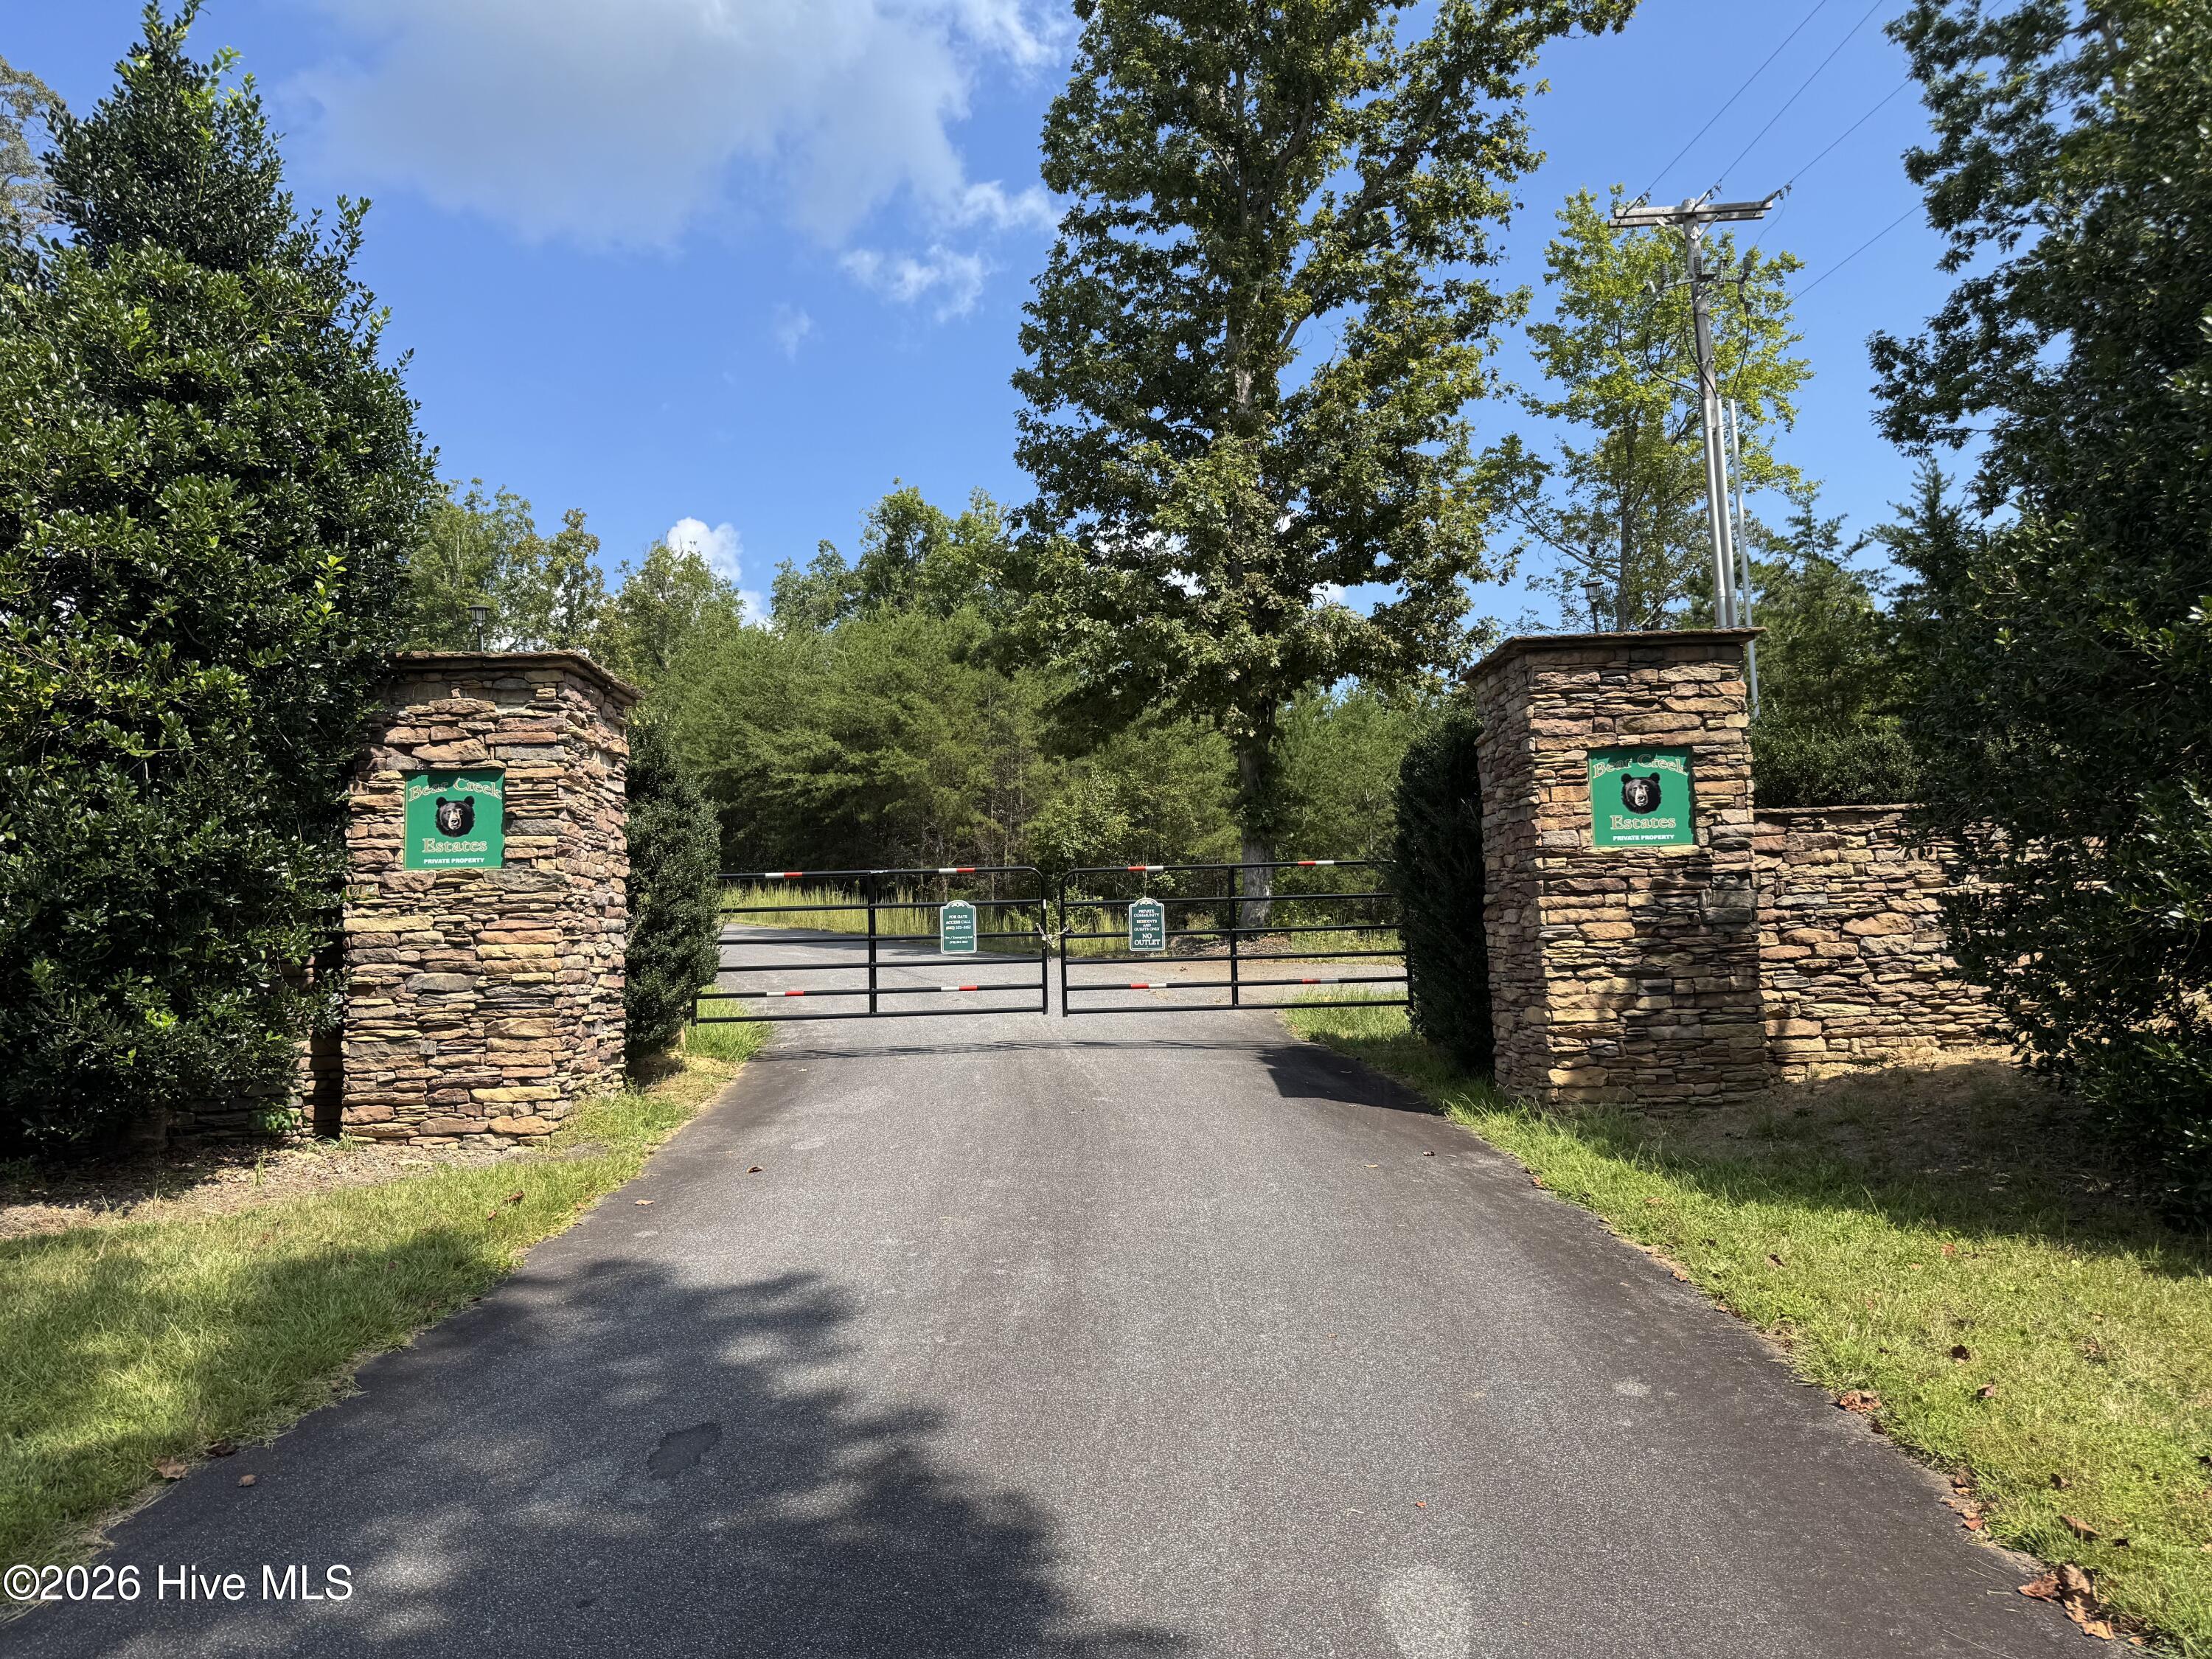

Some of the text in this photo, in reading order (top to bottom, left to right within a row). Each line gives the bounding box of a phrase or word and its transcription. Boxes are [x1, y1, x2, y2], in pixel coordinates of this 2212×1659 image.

[1593, 754, 1688, 779] Bear Creek
[408, 776, 503, 802] Bear Creek
[1610, 815, 1676, 830] Estates
[422, 838, 488, 853] Estates
